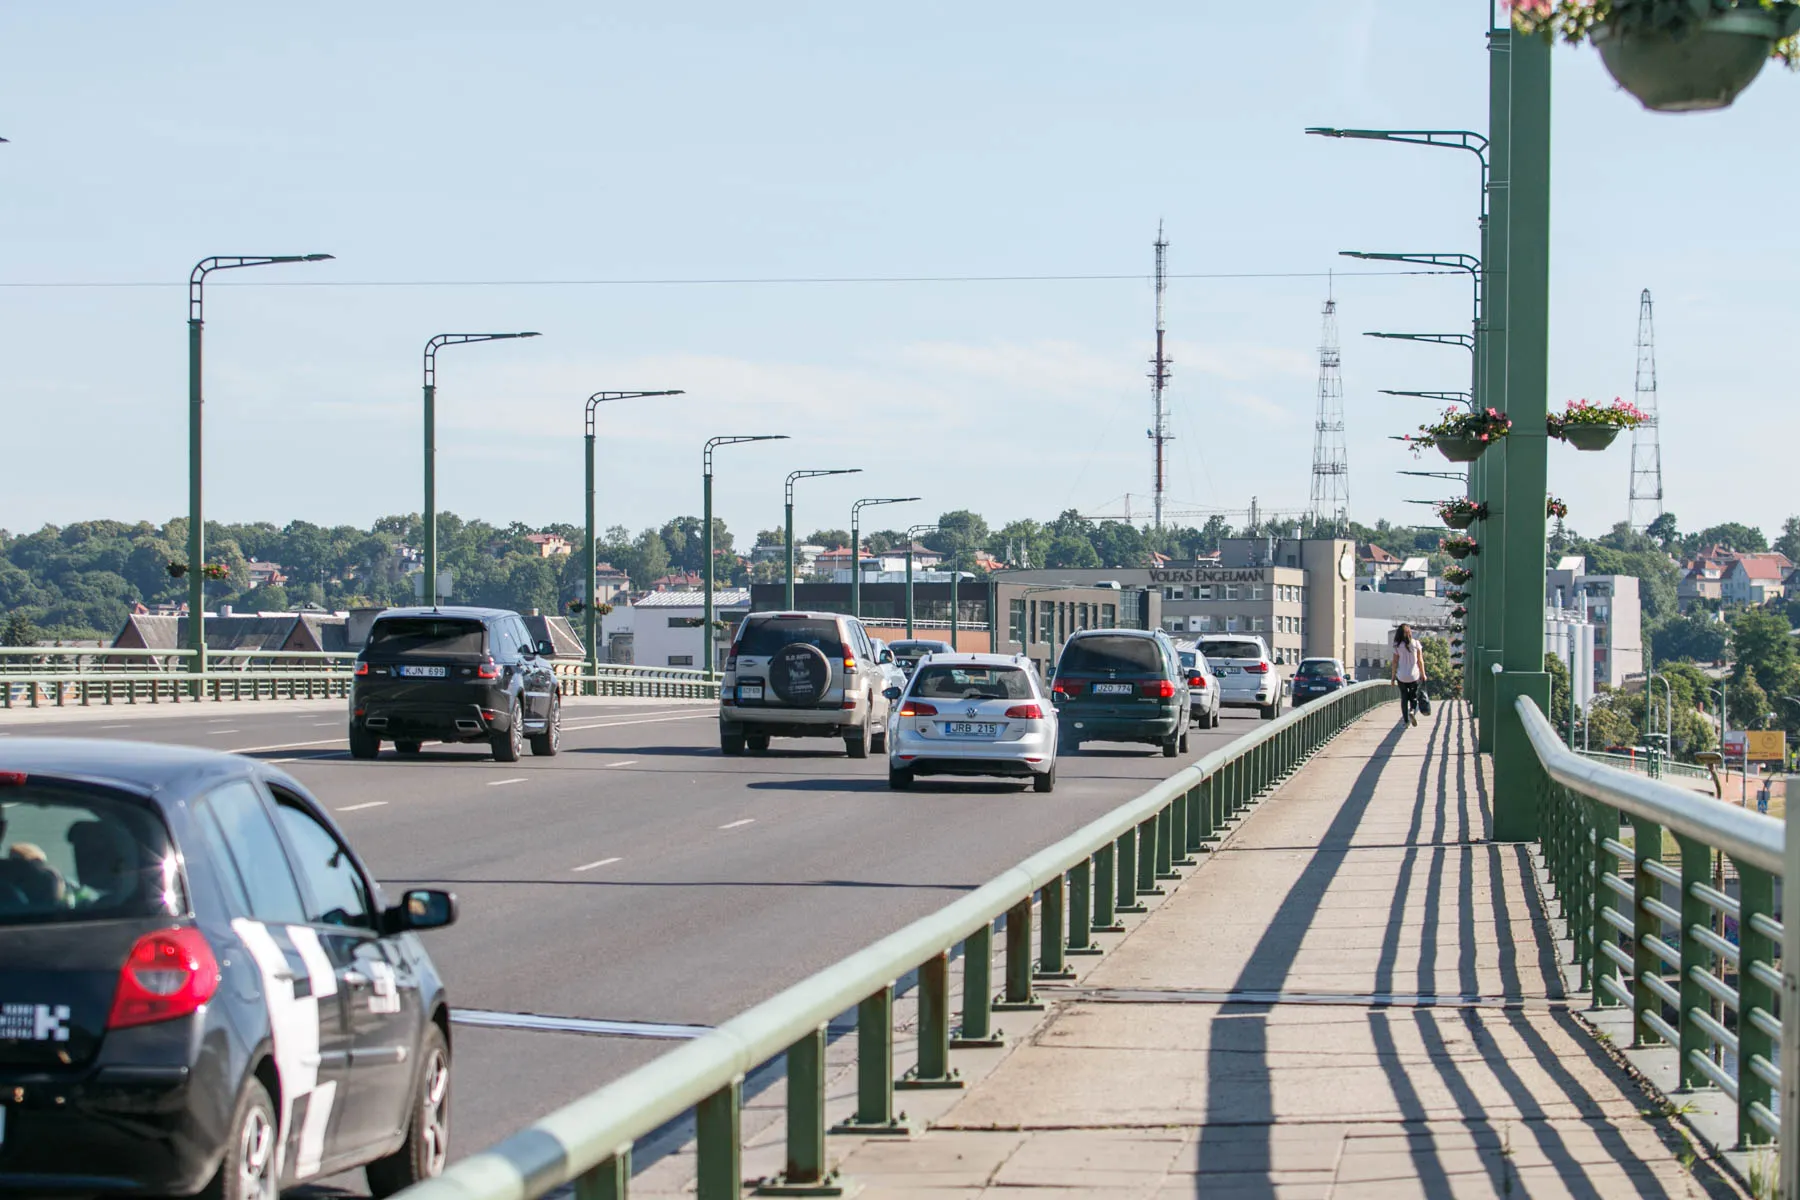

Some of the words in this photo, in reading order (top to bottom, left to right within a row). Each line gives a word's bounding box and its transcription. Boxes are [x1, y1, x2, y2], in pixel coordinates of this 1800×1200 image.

[1149, 570, 1193, 582] VOLFAS
[1195, 569, 1265, 582] ENGELMAN
[405, 667, 424, 675] KJN
[428, 667, 444, 676] 699
[951, 723, 972, 732] JRB
[977, 724, 995, 733] 215
